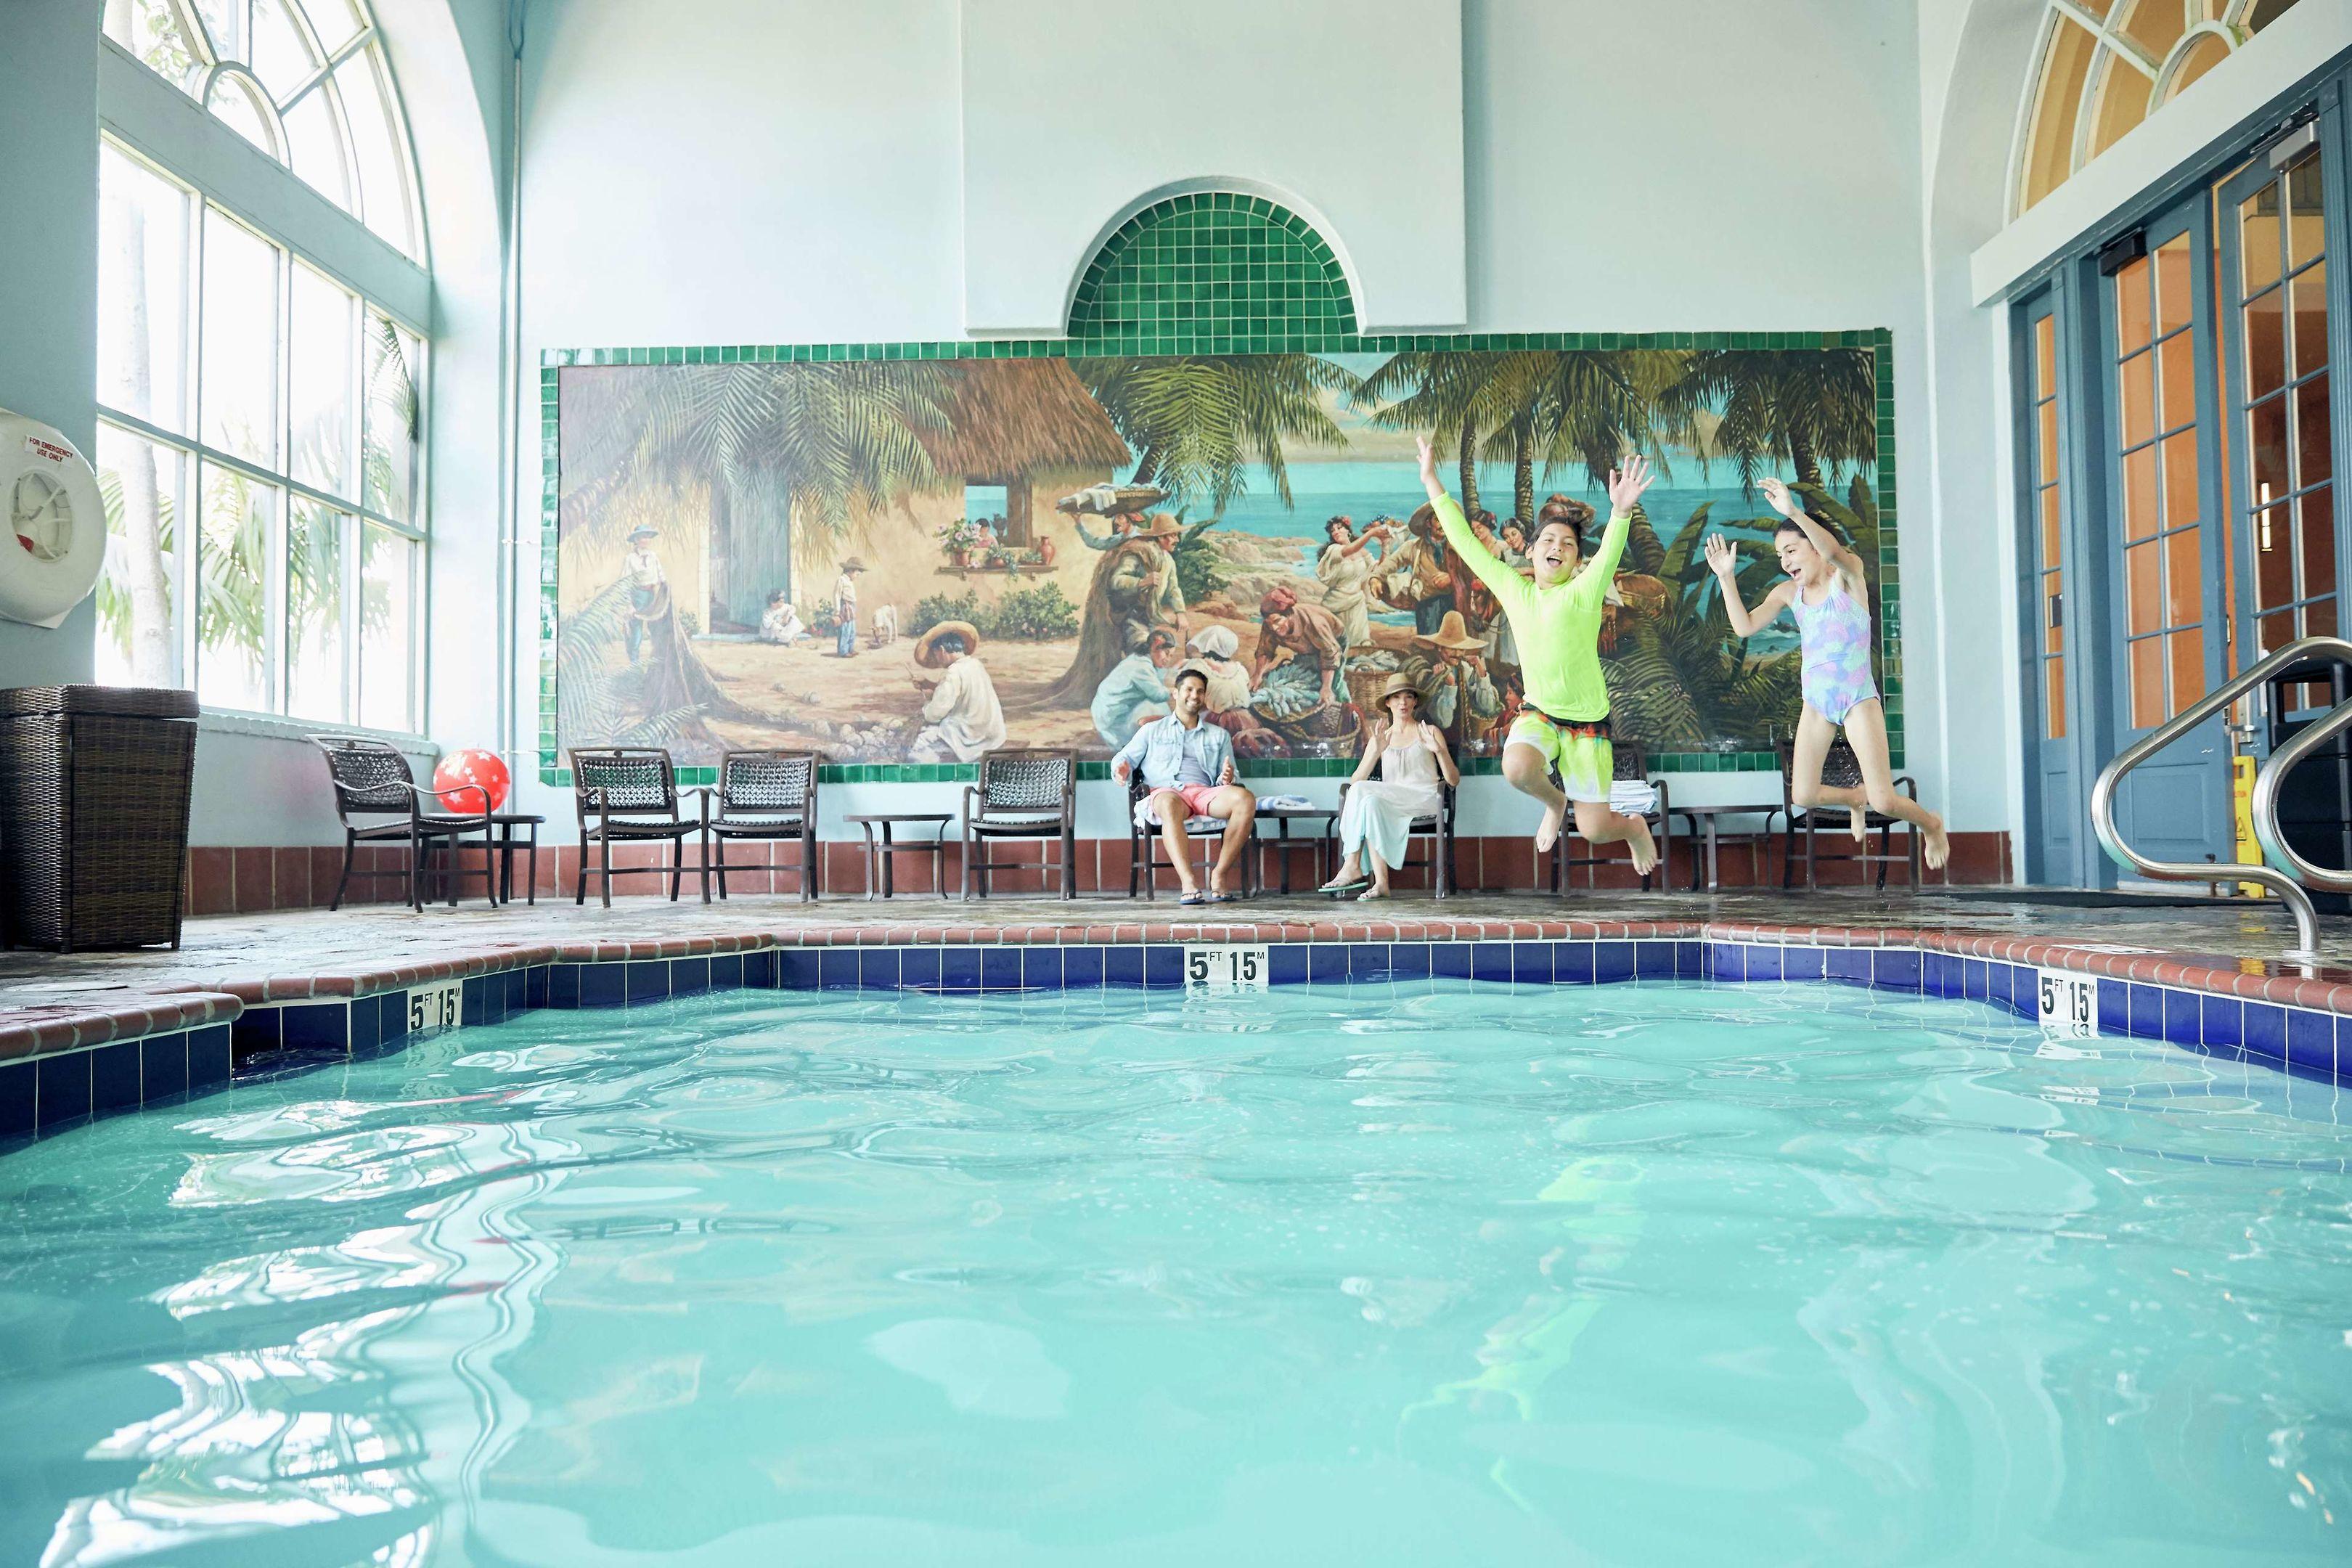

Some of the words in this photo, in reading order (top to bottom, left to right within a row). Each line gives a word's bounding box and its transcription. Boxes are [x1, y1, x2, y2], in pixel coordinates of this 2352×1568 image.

[30, 437, 40, 446] FOR
[41, 441, 73, 458] EMERGENCY
[37, 448, 48, 457] USE
[49, 452, 63, 462] ONLY
